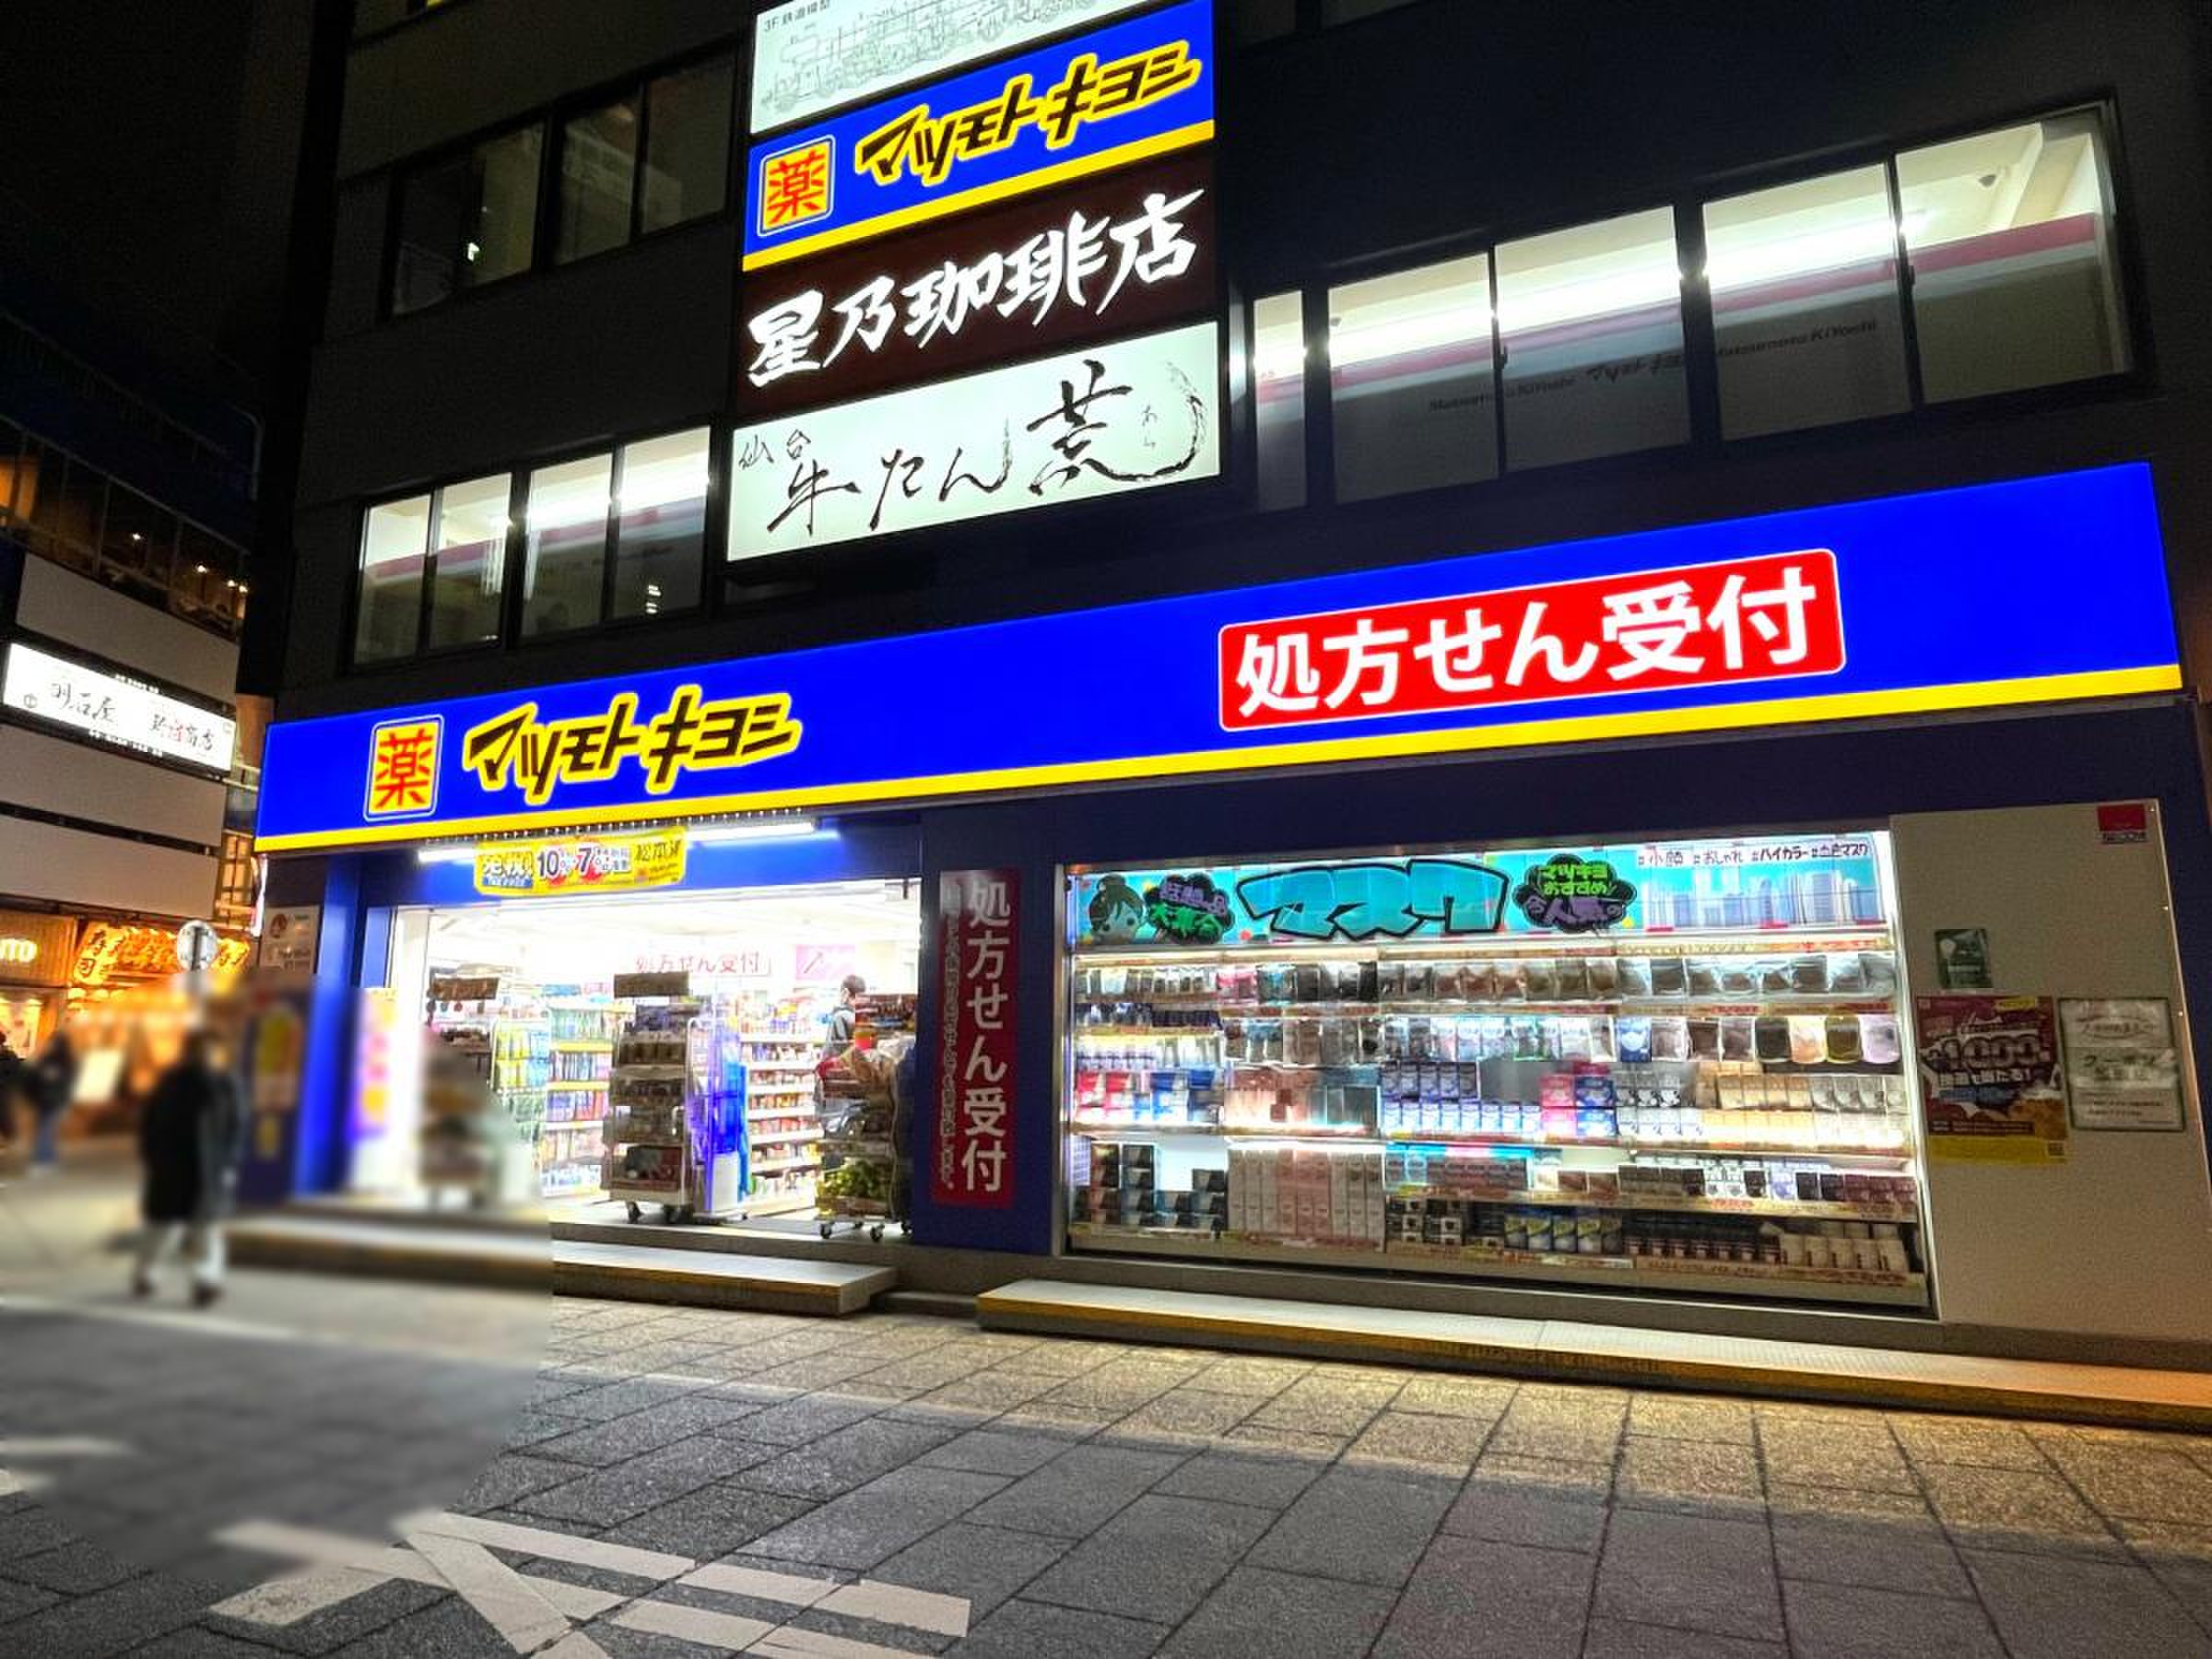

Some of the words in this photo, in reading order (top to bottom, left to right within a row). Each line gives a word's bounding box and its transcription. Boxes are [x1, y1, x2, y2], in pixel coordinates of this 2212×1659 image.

[767, 151, 827, 227] 薬
[855, 40, 1202, 187] マツモトキヨシ
[747, 188, 1205, 387] 星乃珈琲店
[1235, 565, 1817, 717] 処方せん受付
[374, 727, 433, 808] 薬
[463, 685, 801, 805] マツモトキヨシ
[961, 880, 1011, 1193] 処方せん受付
